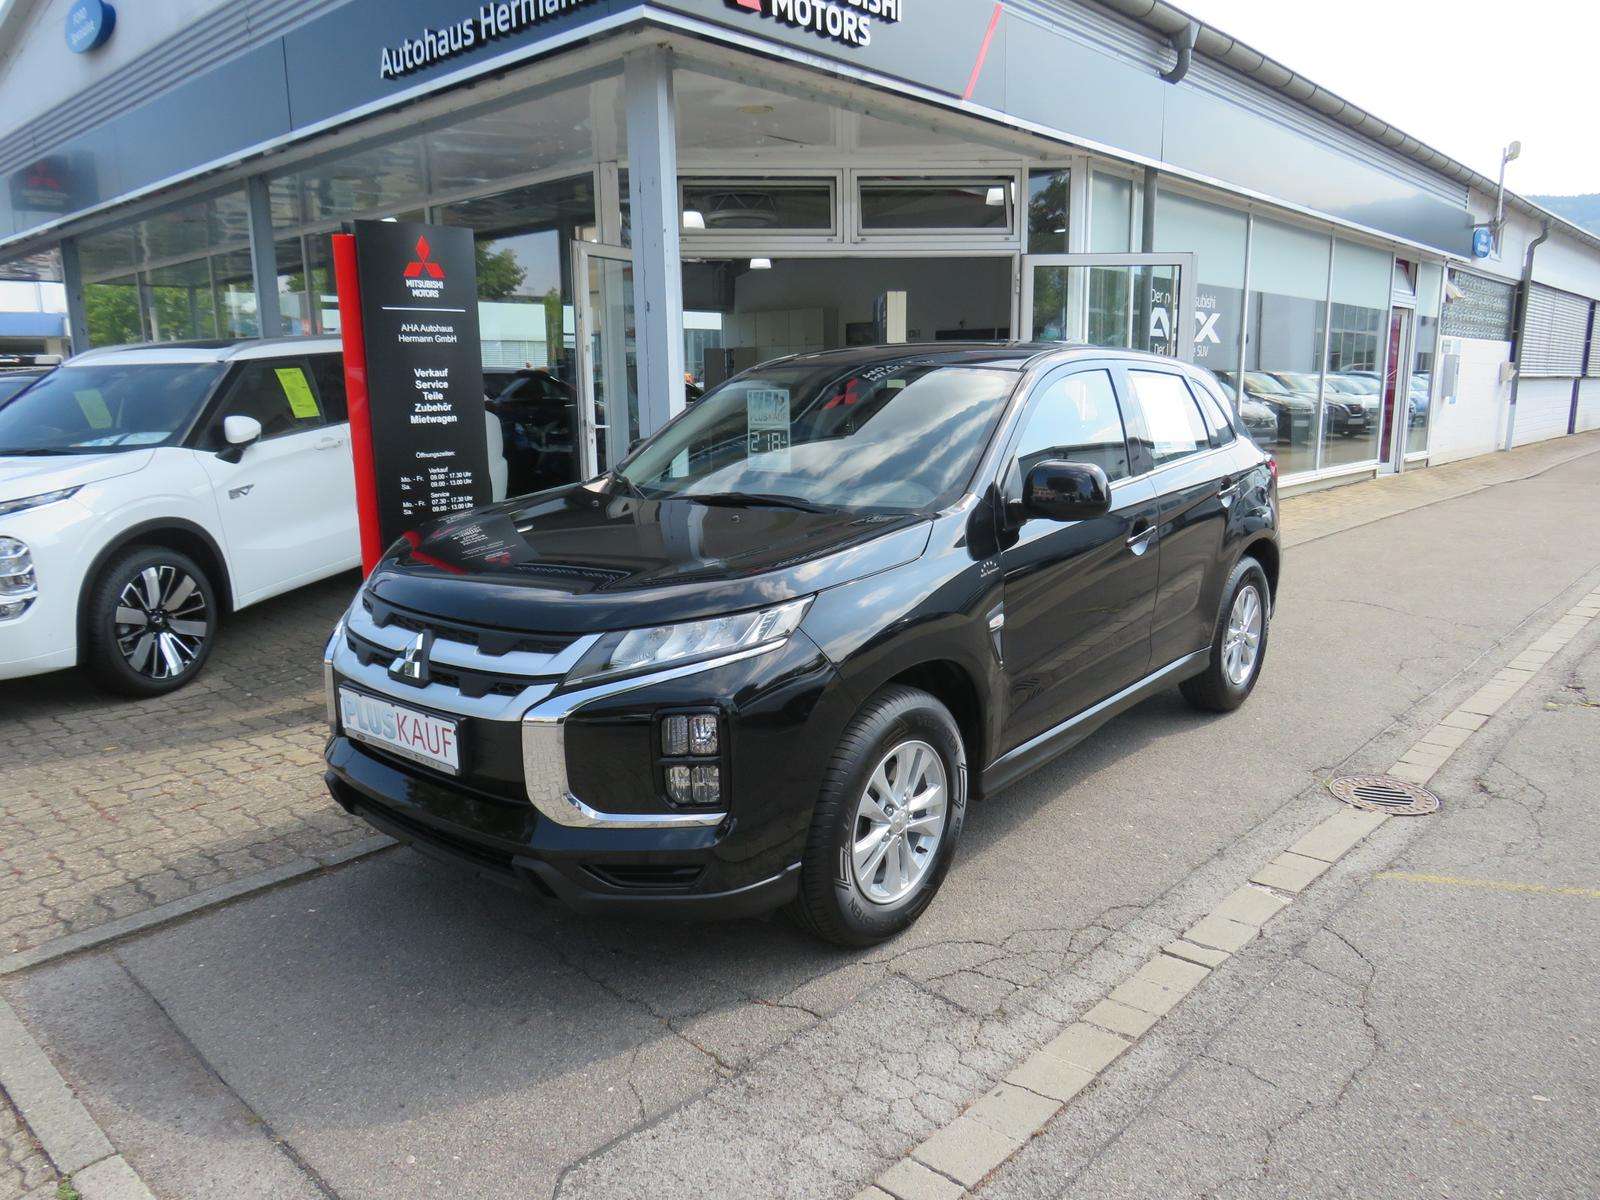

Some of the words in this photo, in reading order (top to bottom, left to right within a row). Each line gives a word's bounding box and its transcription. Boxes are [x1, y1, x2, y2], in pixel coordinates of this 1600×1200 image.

[771, 0, 872, 47] MOTORS
[380, 18, 475, 79] Autohaus
[405, 279, 444, 289] MITSUBISHI
[411, 289, 440, 298] MOTORS
[401, 324, 420, 333] AHA
[420, 324, 454, 333] Autohaus
[398, 335, 433, 343] Hermann
[434, 335, 457, 343] GmbH
[413, 368, 449, 378] Verkauf
[415, 380, 449, 389] Service
[422, 391, 444, 400] Teile
[414, 402, 452, 412] Zubehör
[410, 415, 458, 425] Mietwagen
